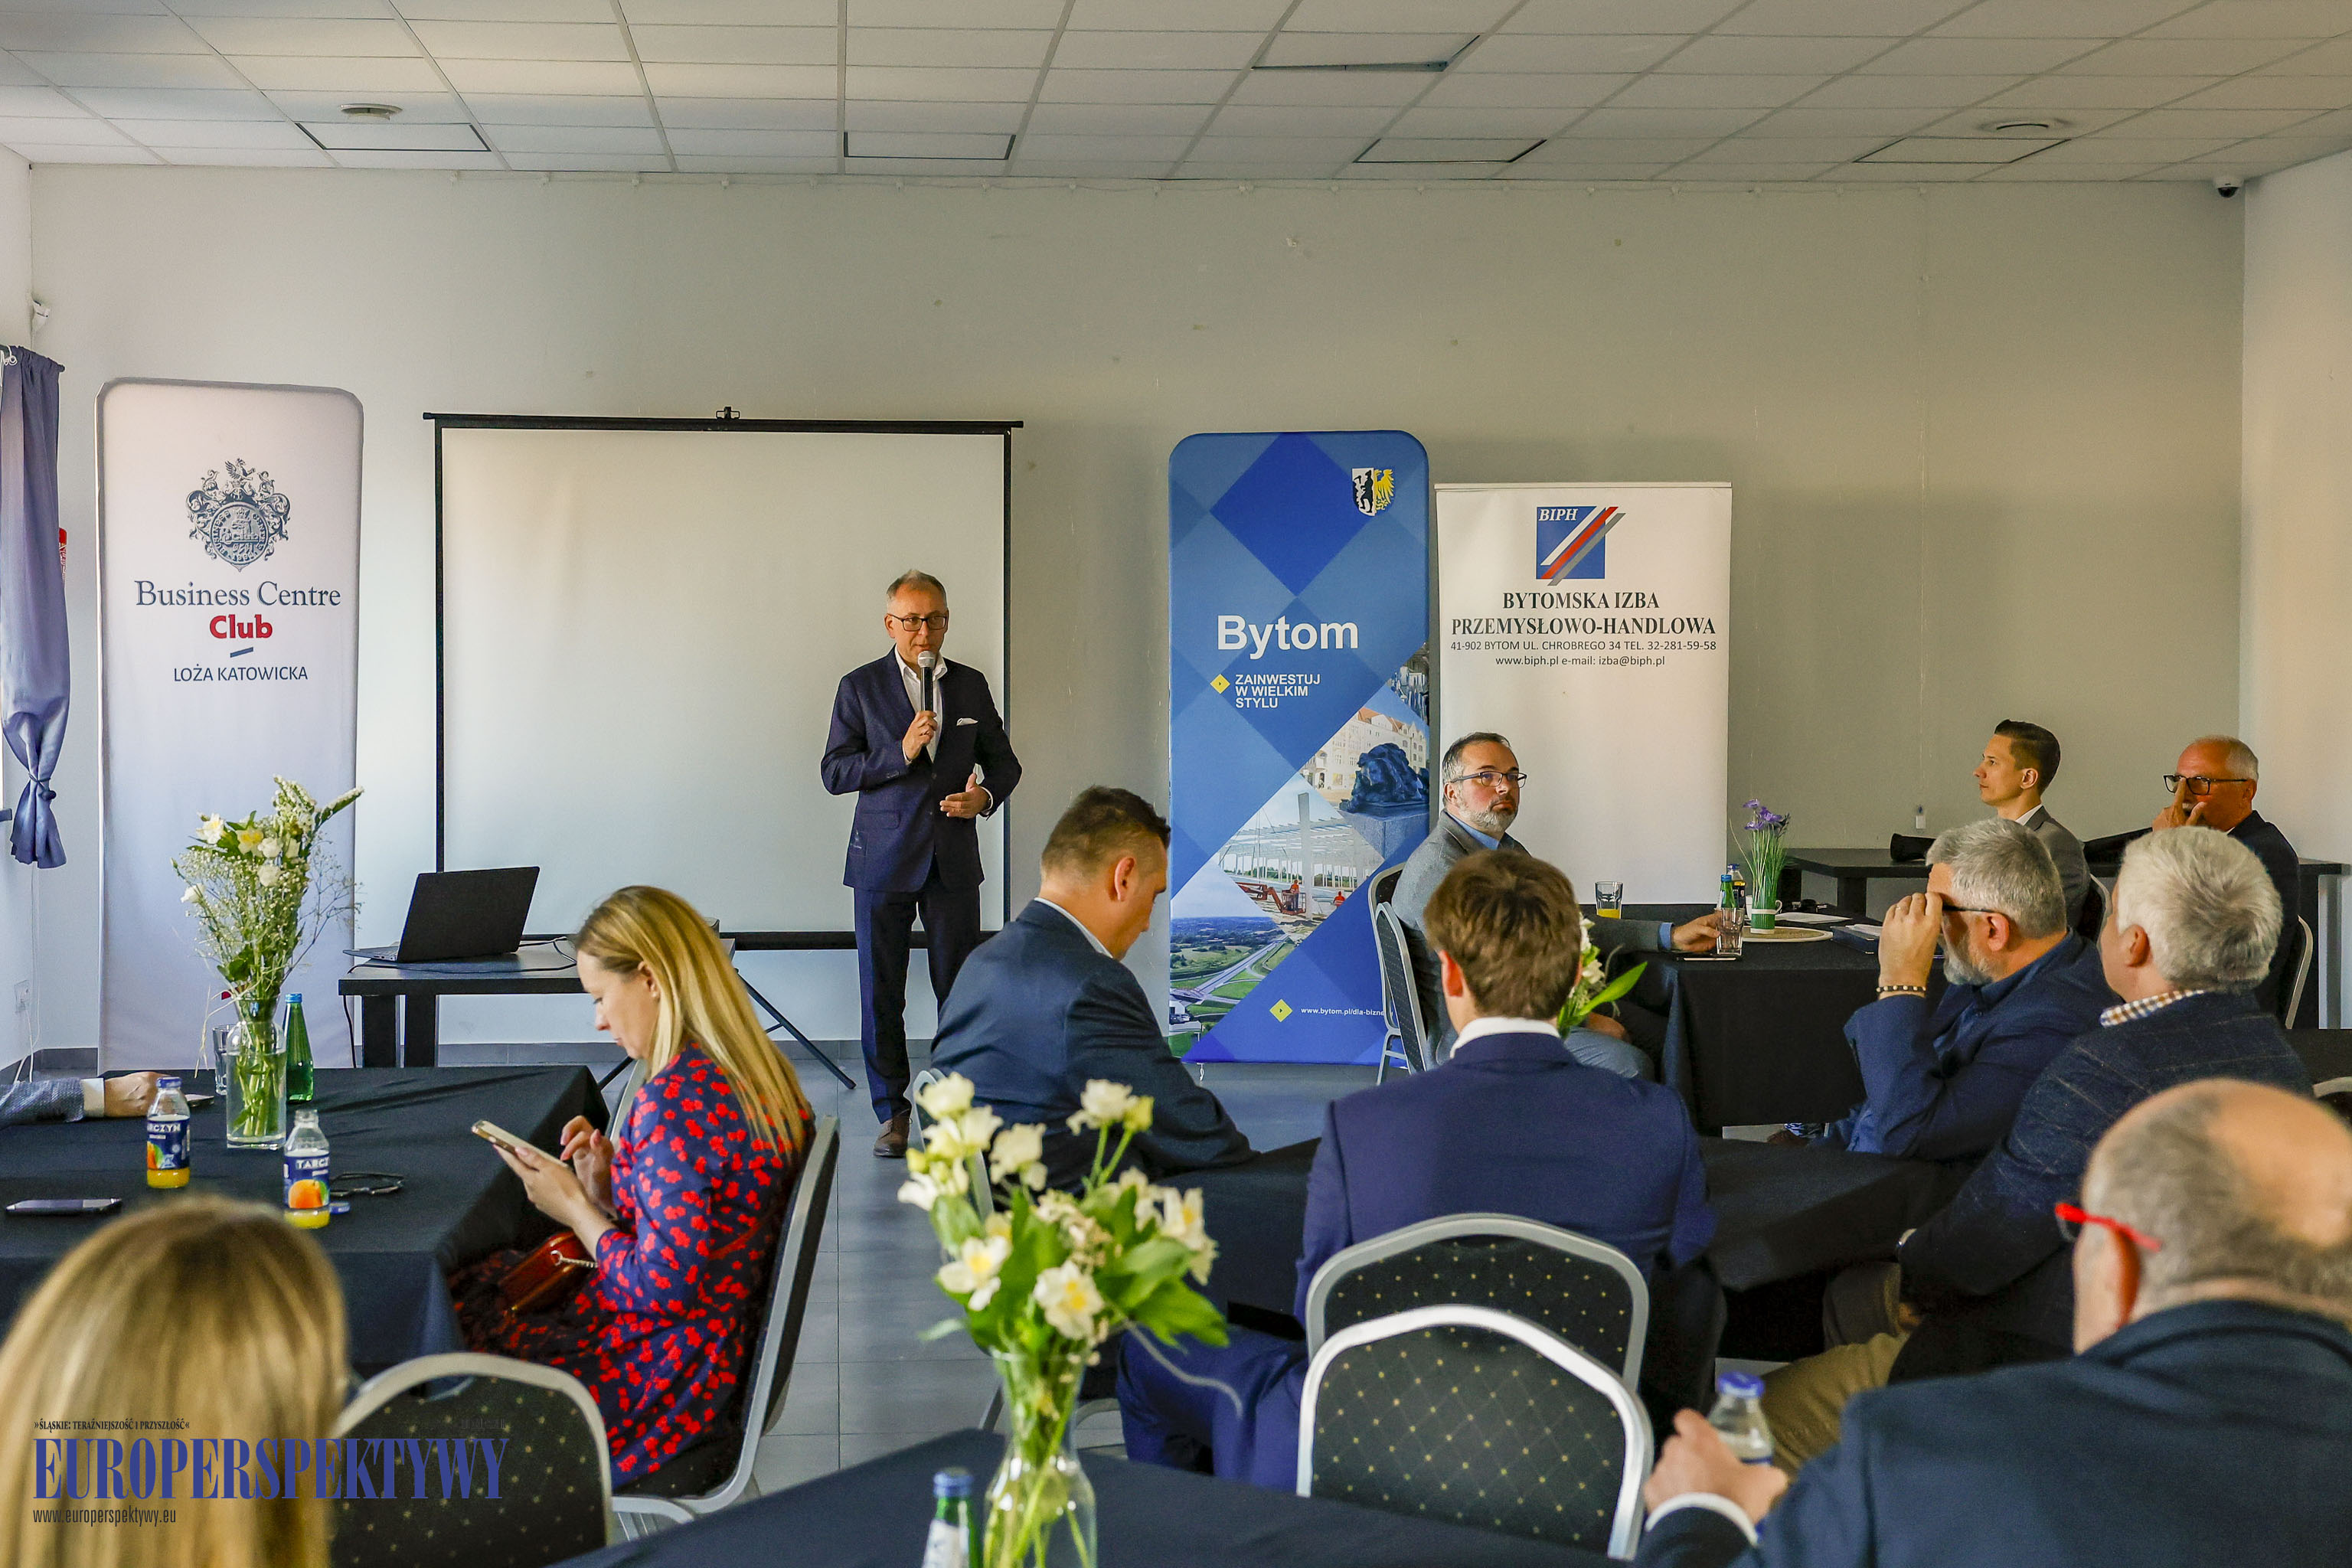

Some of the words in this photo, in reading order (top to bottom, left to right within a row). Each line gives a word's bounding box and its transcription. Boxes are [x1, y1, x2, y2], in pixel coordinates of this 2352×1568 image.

[1538, 508, 1578, 521] BIPH
[134, 580, 250, 606] Business
[256, 580, 341, 606] Centre
[1502, 592, 1609, 609] BYTOMSKA
[1614, 592, 1660, 609] IZBA
[209, 614, 273, 639] Club
[1452, 617, 1716, 635] PRZEMYSŁOWO-HANDLOWA
[1217, 615, 1358, 660] Bytom
[1450, 641, 1481, 651] 41-902
[1485, 641, 1520, 650] BYTOM
[1523, 641, 1539, 650] UL.
[1542, 641, 1606, 650] CHROBREGO
[1609, 641, 1621, 650] 34
[1624, 641, 1644, 650] TEL.
[1647, 641, 1717, 651] 32-281-59-58
[1495, 656, 1559, 667] www.biph.pl
[1561, 656, 1596, 665] e-mail:
[1599, 656, 1665, 667] izba@biph.pl
[174, 664, 213, 681] LOŻA
[217, 666, 308, 681] KATOWICKA
[1235, 674, 1321, 685] ZAINWESTUJ
[1236, 686, 1250, 696] W
[1251, 685, 1308, 696] WIELKIM
[1235, 697, 1279, 708] STYLU
